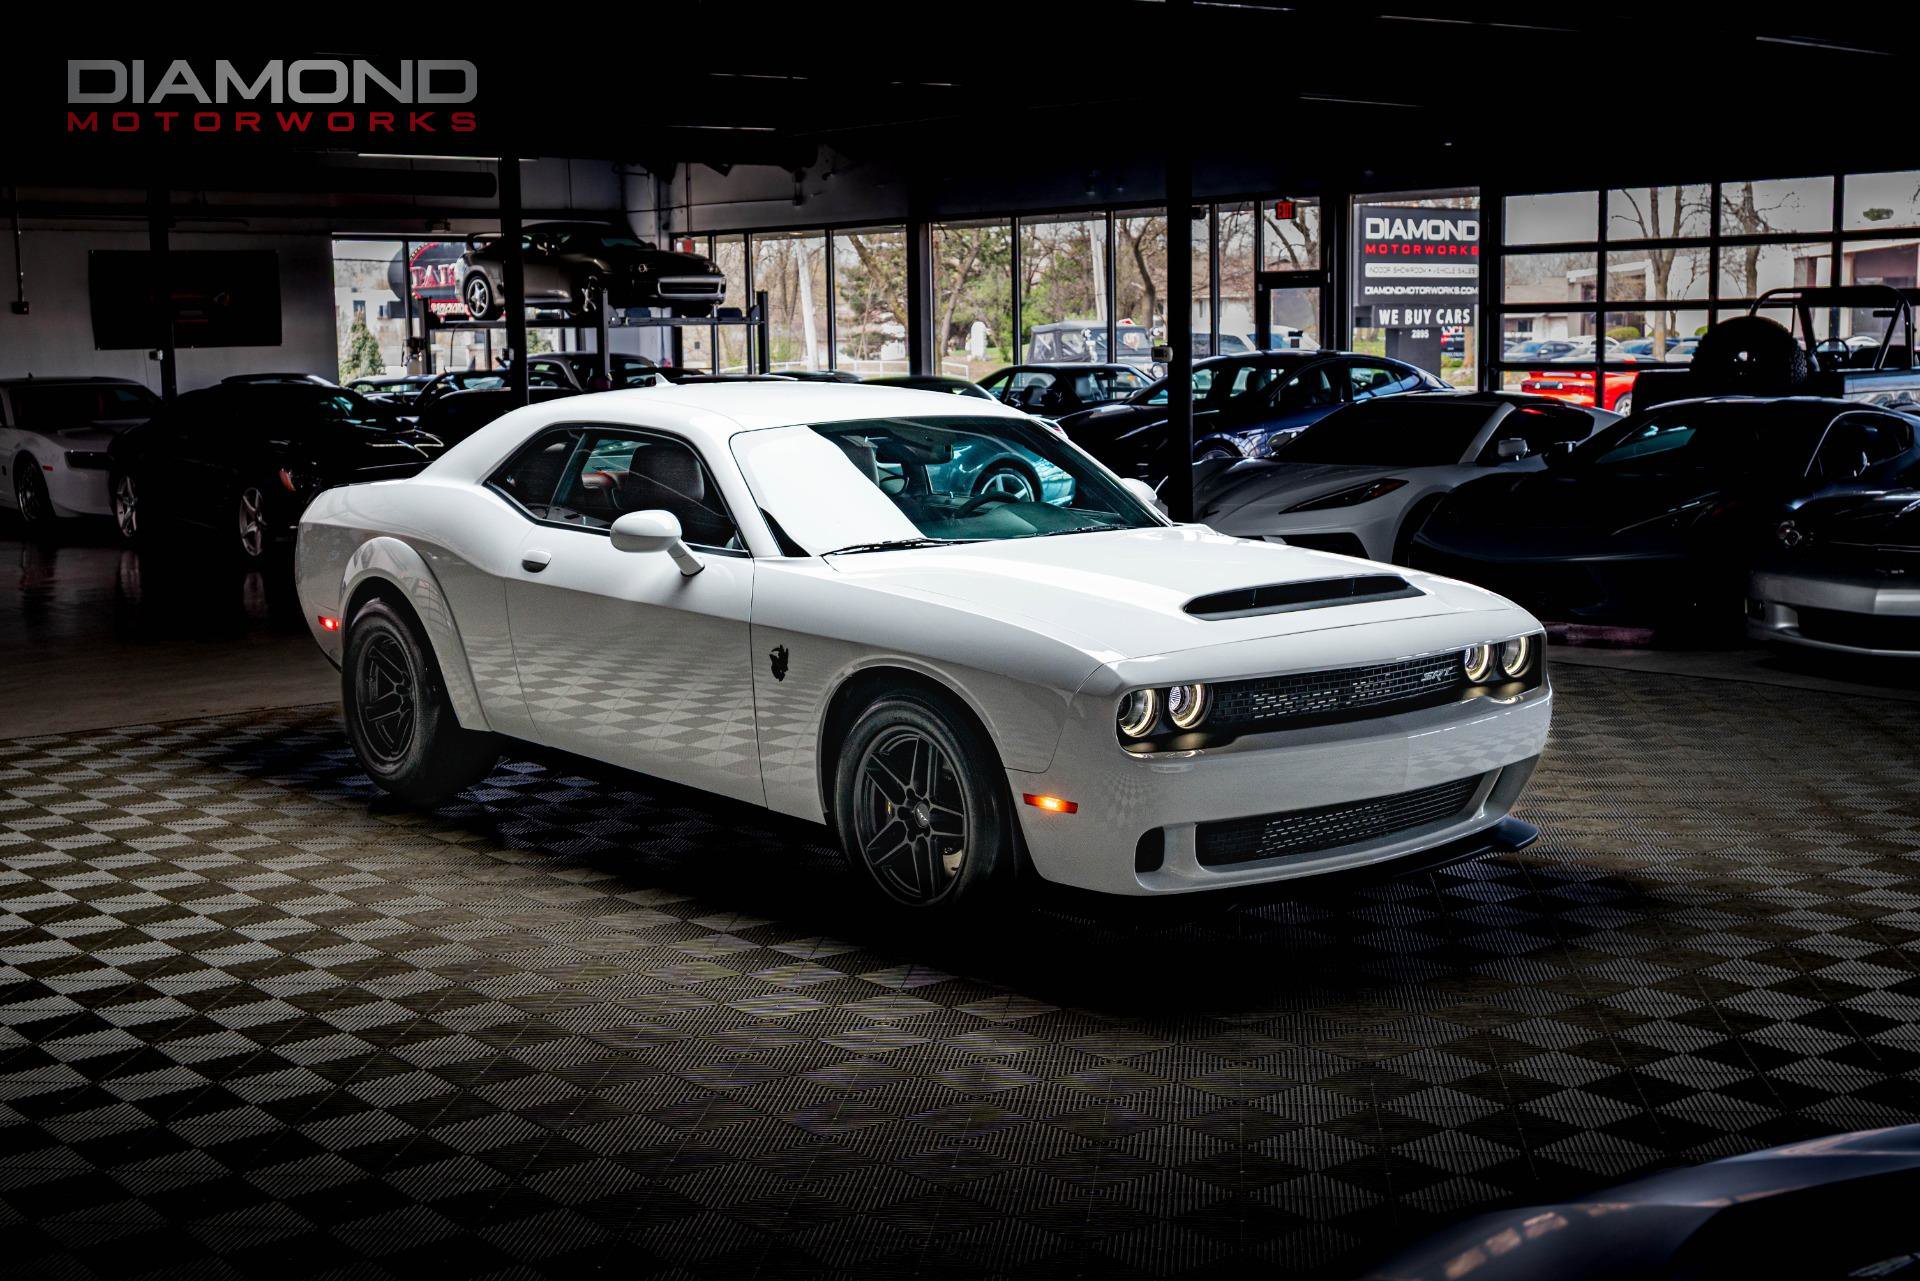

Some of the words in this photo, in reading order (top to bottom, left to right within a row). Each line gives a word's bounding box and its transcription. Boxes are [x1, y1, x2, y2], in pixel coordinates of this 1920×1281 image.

[1365, 217, 1479, 241] DIAMOND
[1365, 244, 1479, 255] MOTORWORKS
[1364, 286, 1478, 295] DIAMONDMOTORWORKS.COM
[1379, 309, 1399, 325] WE
[1404, 308, 1432, 325] BUY
[1435, 308, 1471, 325] CARS
[1421, 666, 1453, 682] SRT
